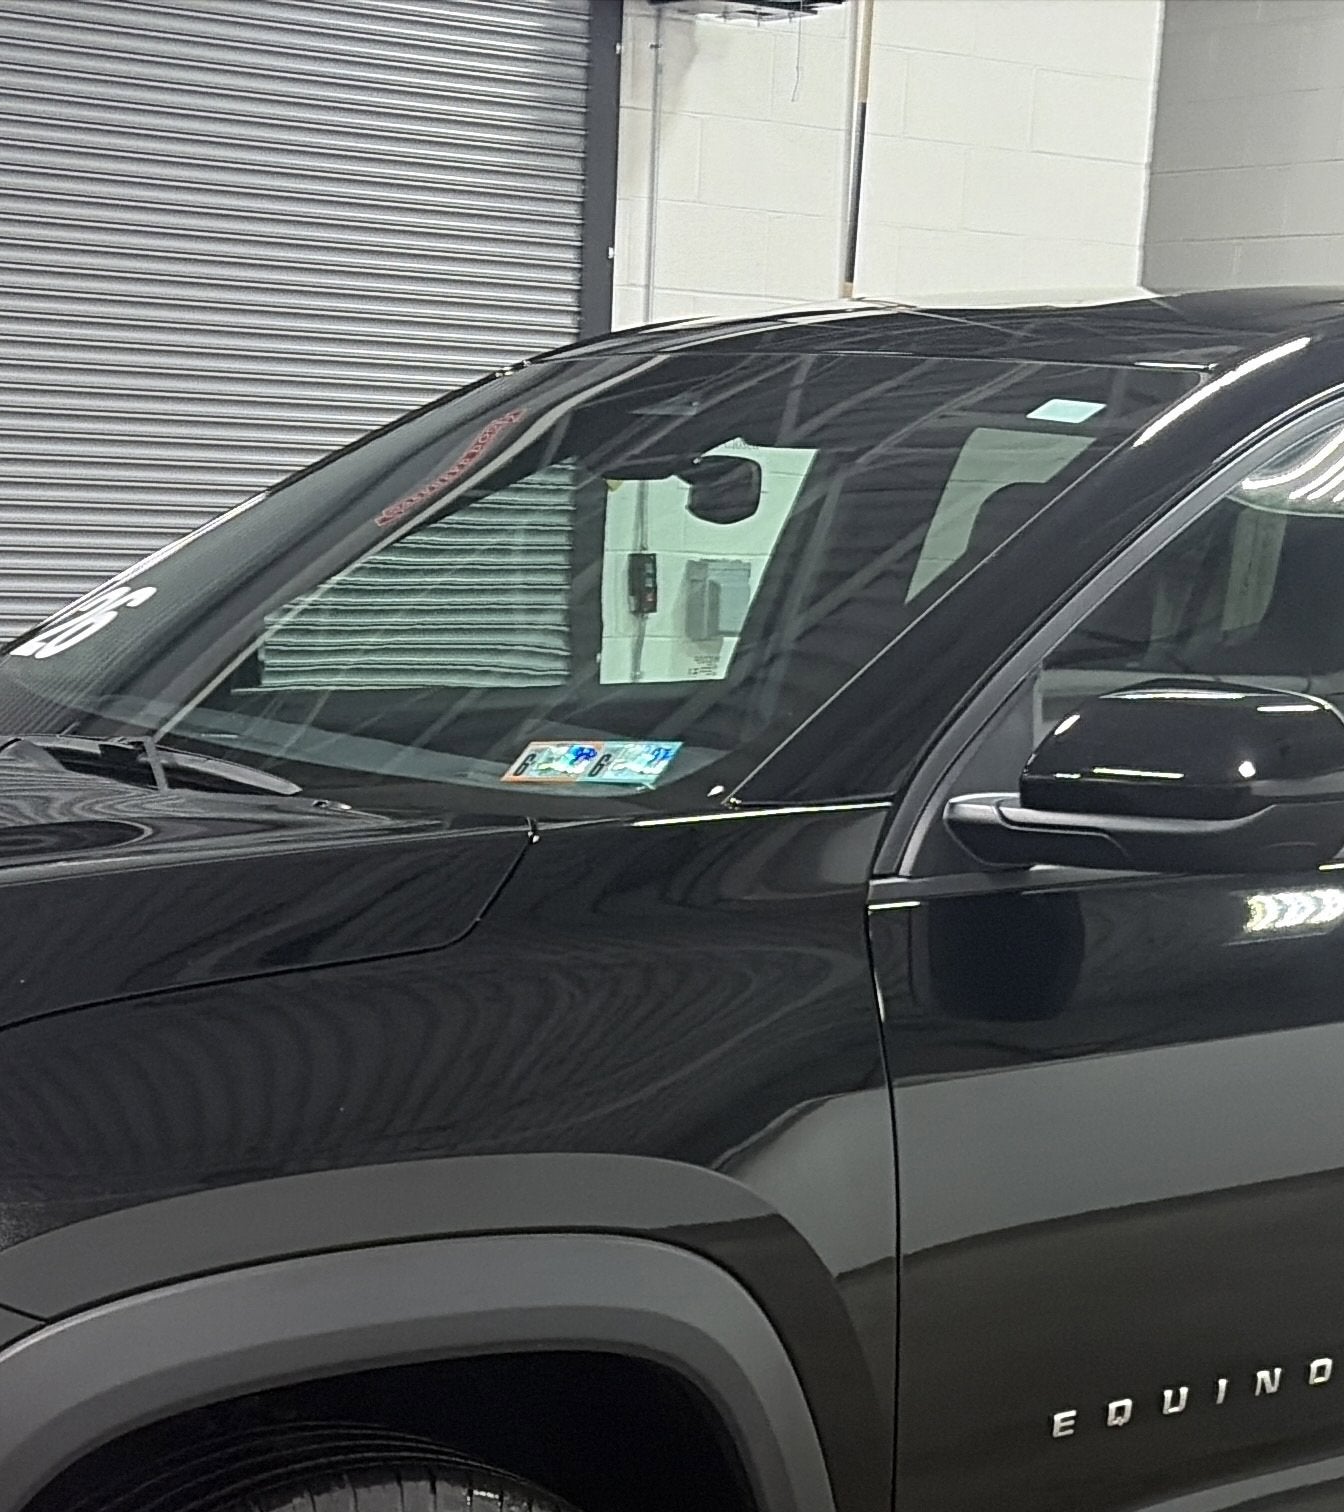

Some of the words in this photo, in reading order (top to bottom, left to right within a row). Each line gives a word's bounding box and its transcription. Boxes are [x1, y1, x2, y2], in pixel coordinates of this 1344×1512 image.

[9, 586, 157, 659] 26
[512, 753, 537, 777] 6
[587, 753, 612, 778] 6
